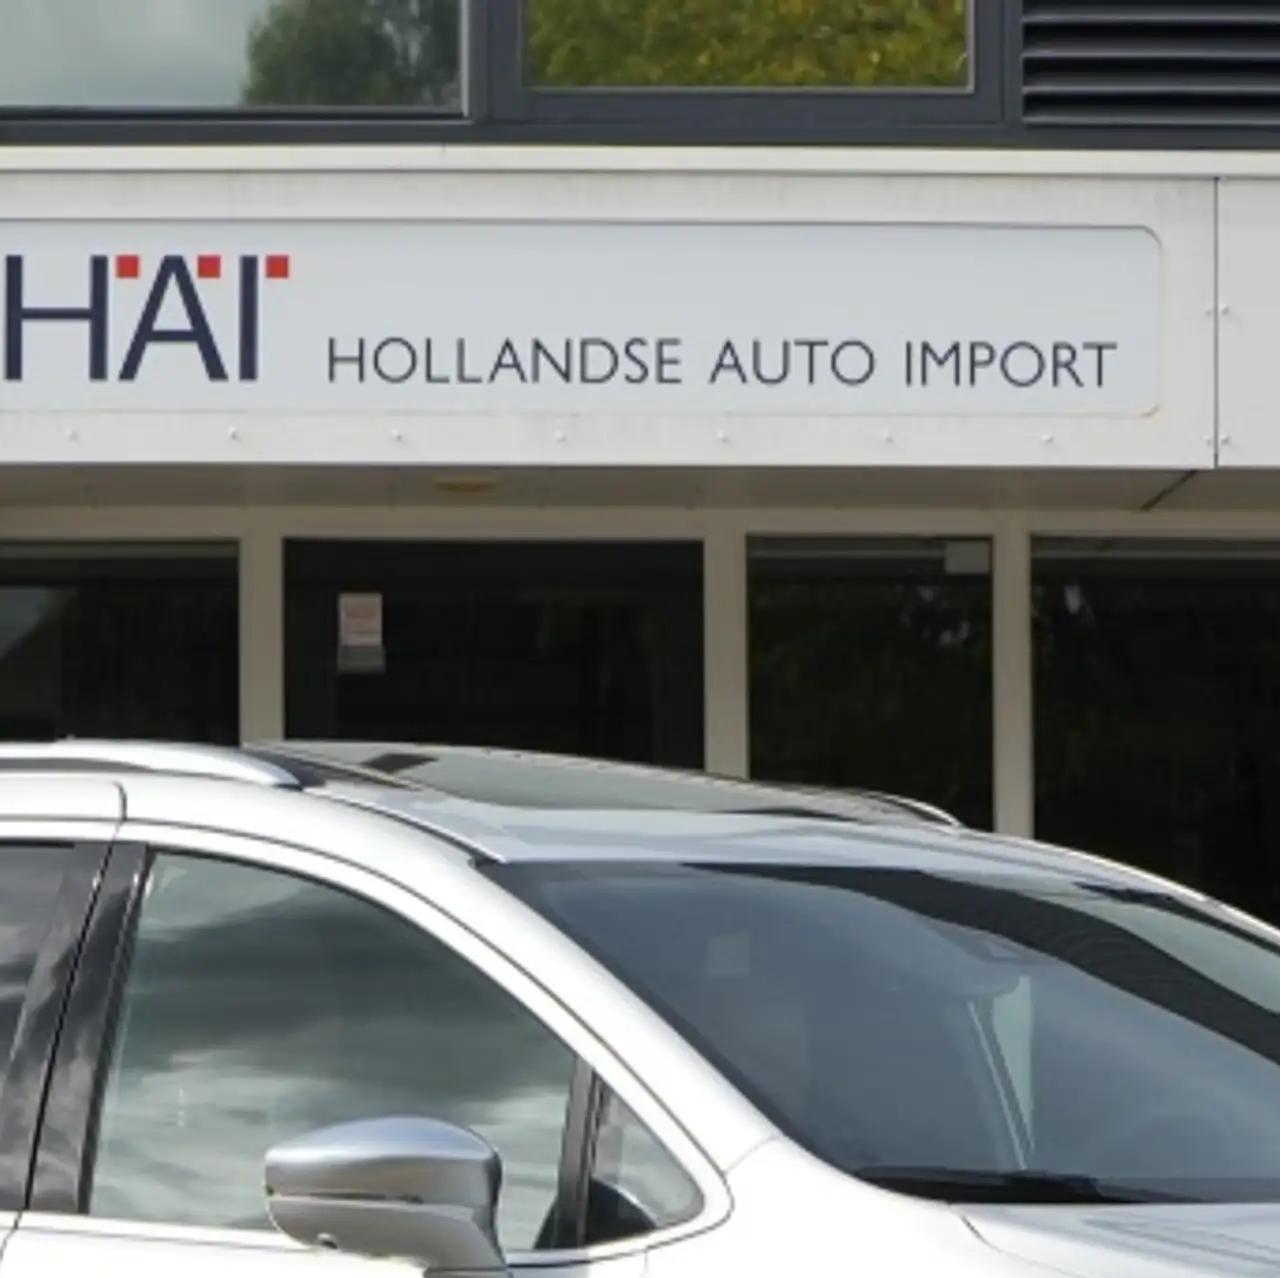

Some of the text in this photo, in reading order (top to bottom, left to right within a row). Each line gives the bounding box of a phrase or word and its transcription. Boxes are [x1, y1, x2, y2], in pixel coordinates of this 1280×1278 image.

[327, 336, 1118, 388] HOLLANDSE AUTO IMPORT
